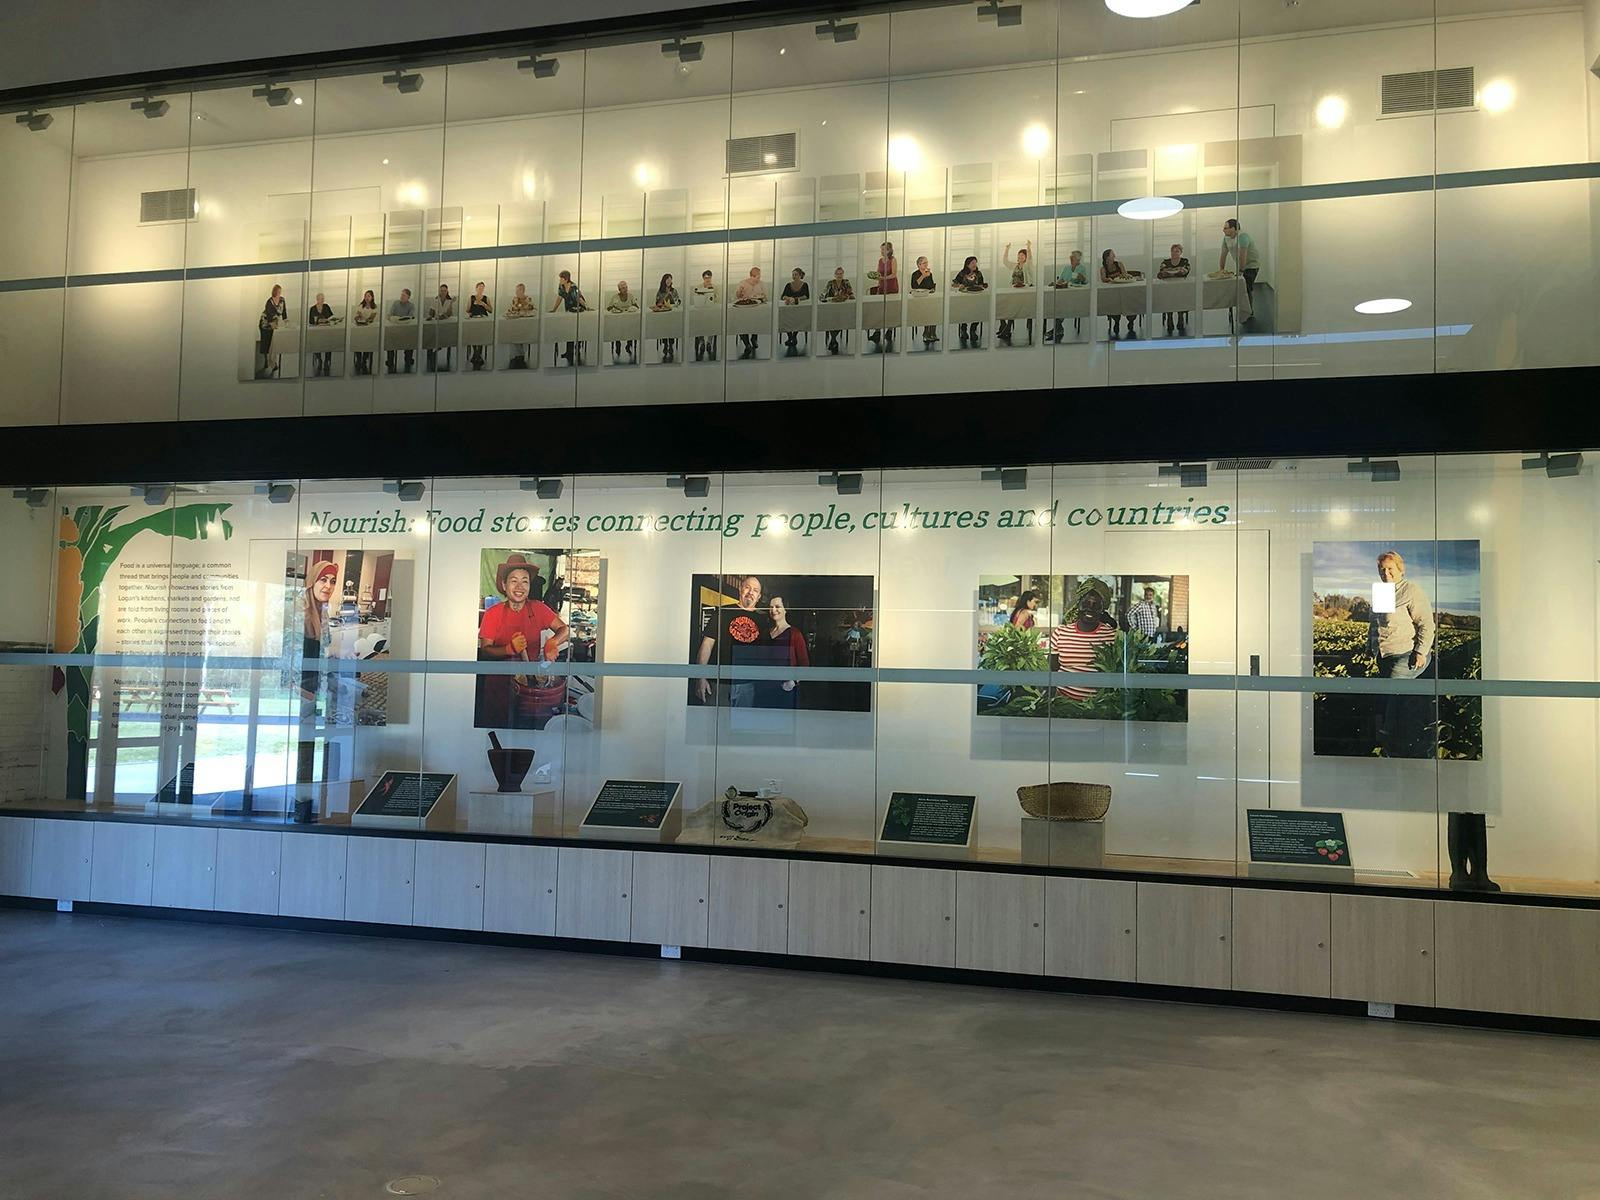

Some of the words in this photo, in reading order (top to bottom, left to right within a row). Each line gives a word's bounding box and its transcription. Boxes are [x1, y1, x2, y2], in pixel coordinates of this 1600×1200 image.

[310, 509, 415, 533] Nourish:
[426, 508, 486, 532] Food
[490, 507, 580, 532] stoies
[586, 506, 744, 538] connecting
[862, 502, 989, 529] cultures
[997, 500, 1058, 529] and
[1067, 496, 1229, 527] countries
[733, 803, 762, 813] Project
[734, 810, 759, 818] Origin
